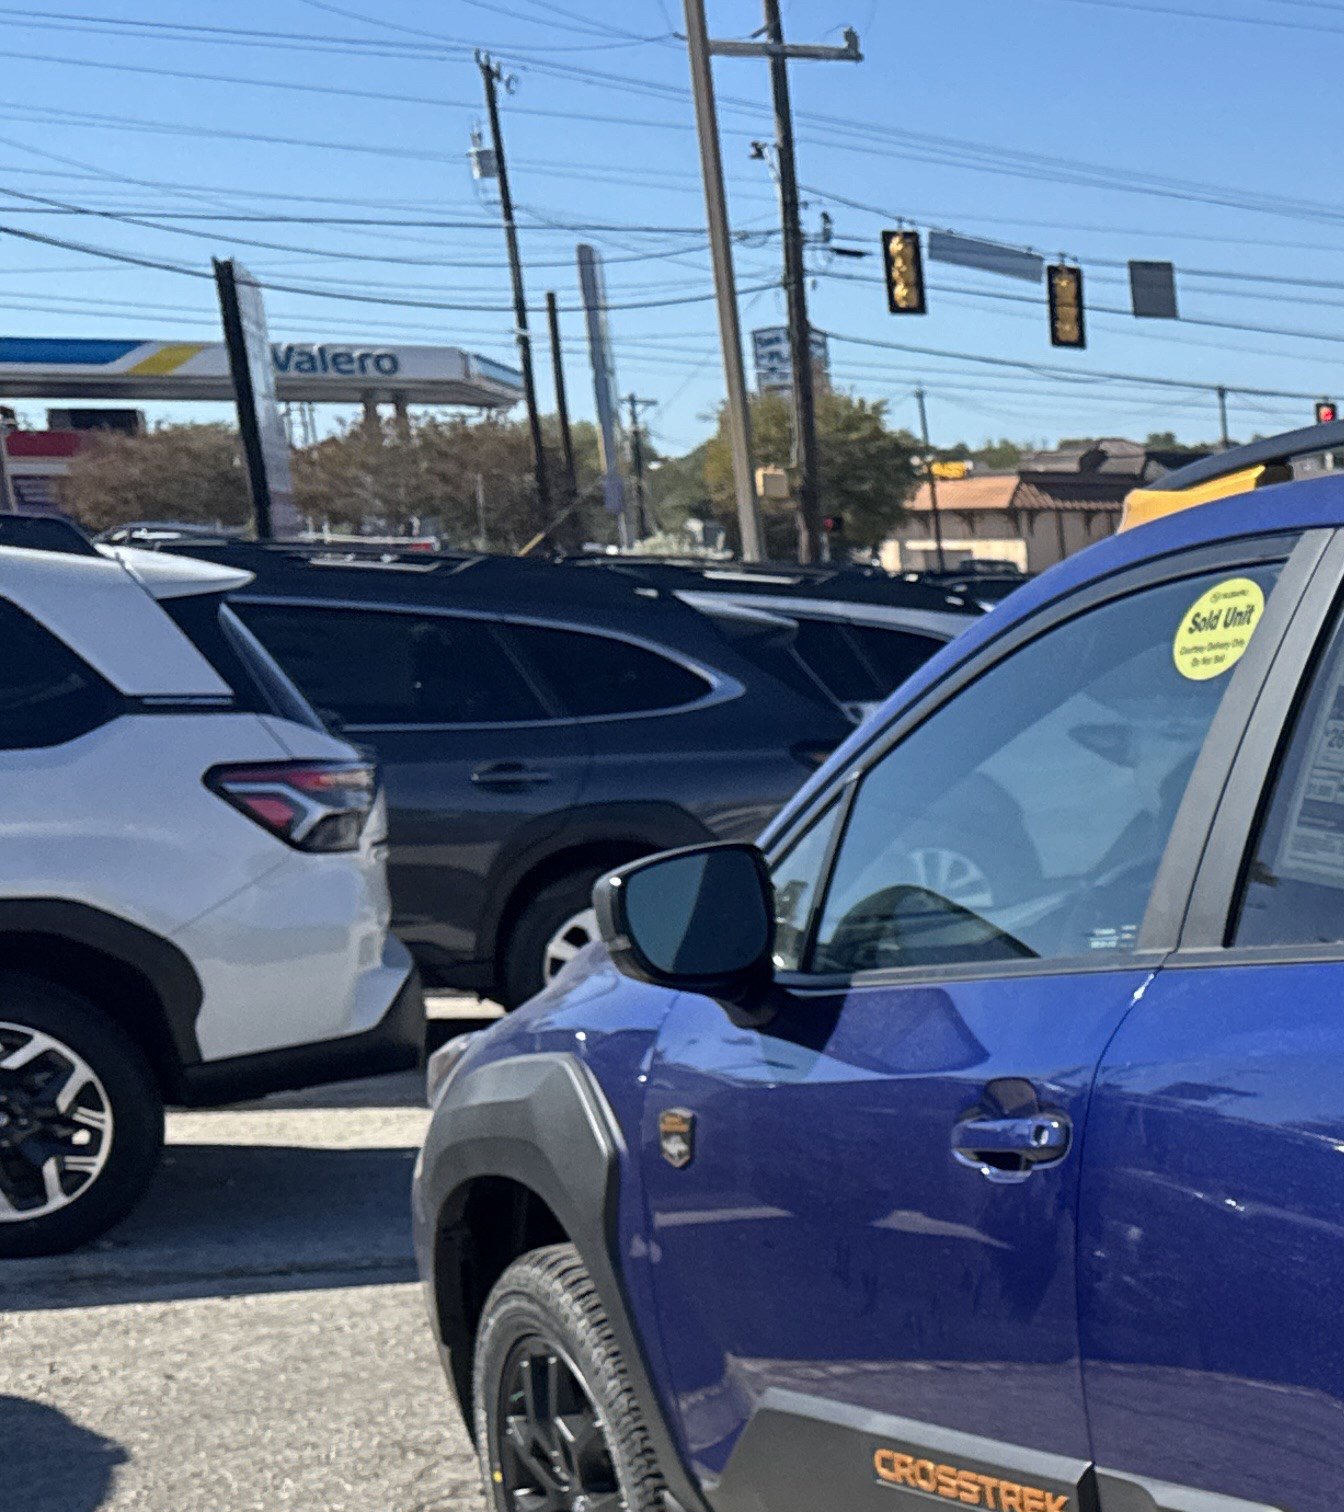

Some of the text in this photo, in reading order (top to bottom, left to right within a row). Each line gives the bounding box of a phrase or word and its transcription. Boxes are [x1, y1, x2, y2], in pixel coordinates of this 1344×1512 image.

[270, 344, 399, 375] Valero
[1188, 604, 1256, 634] Sold Unit
